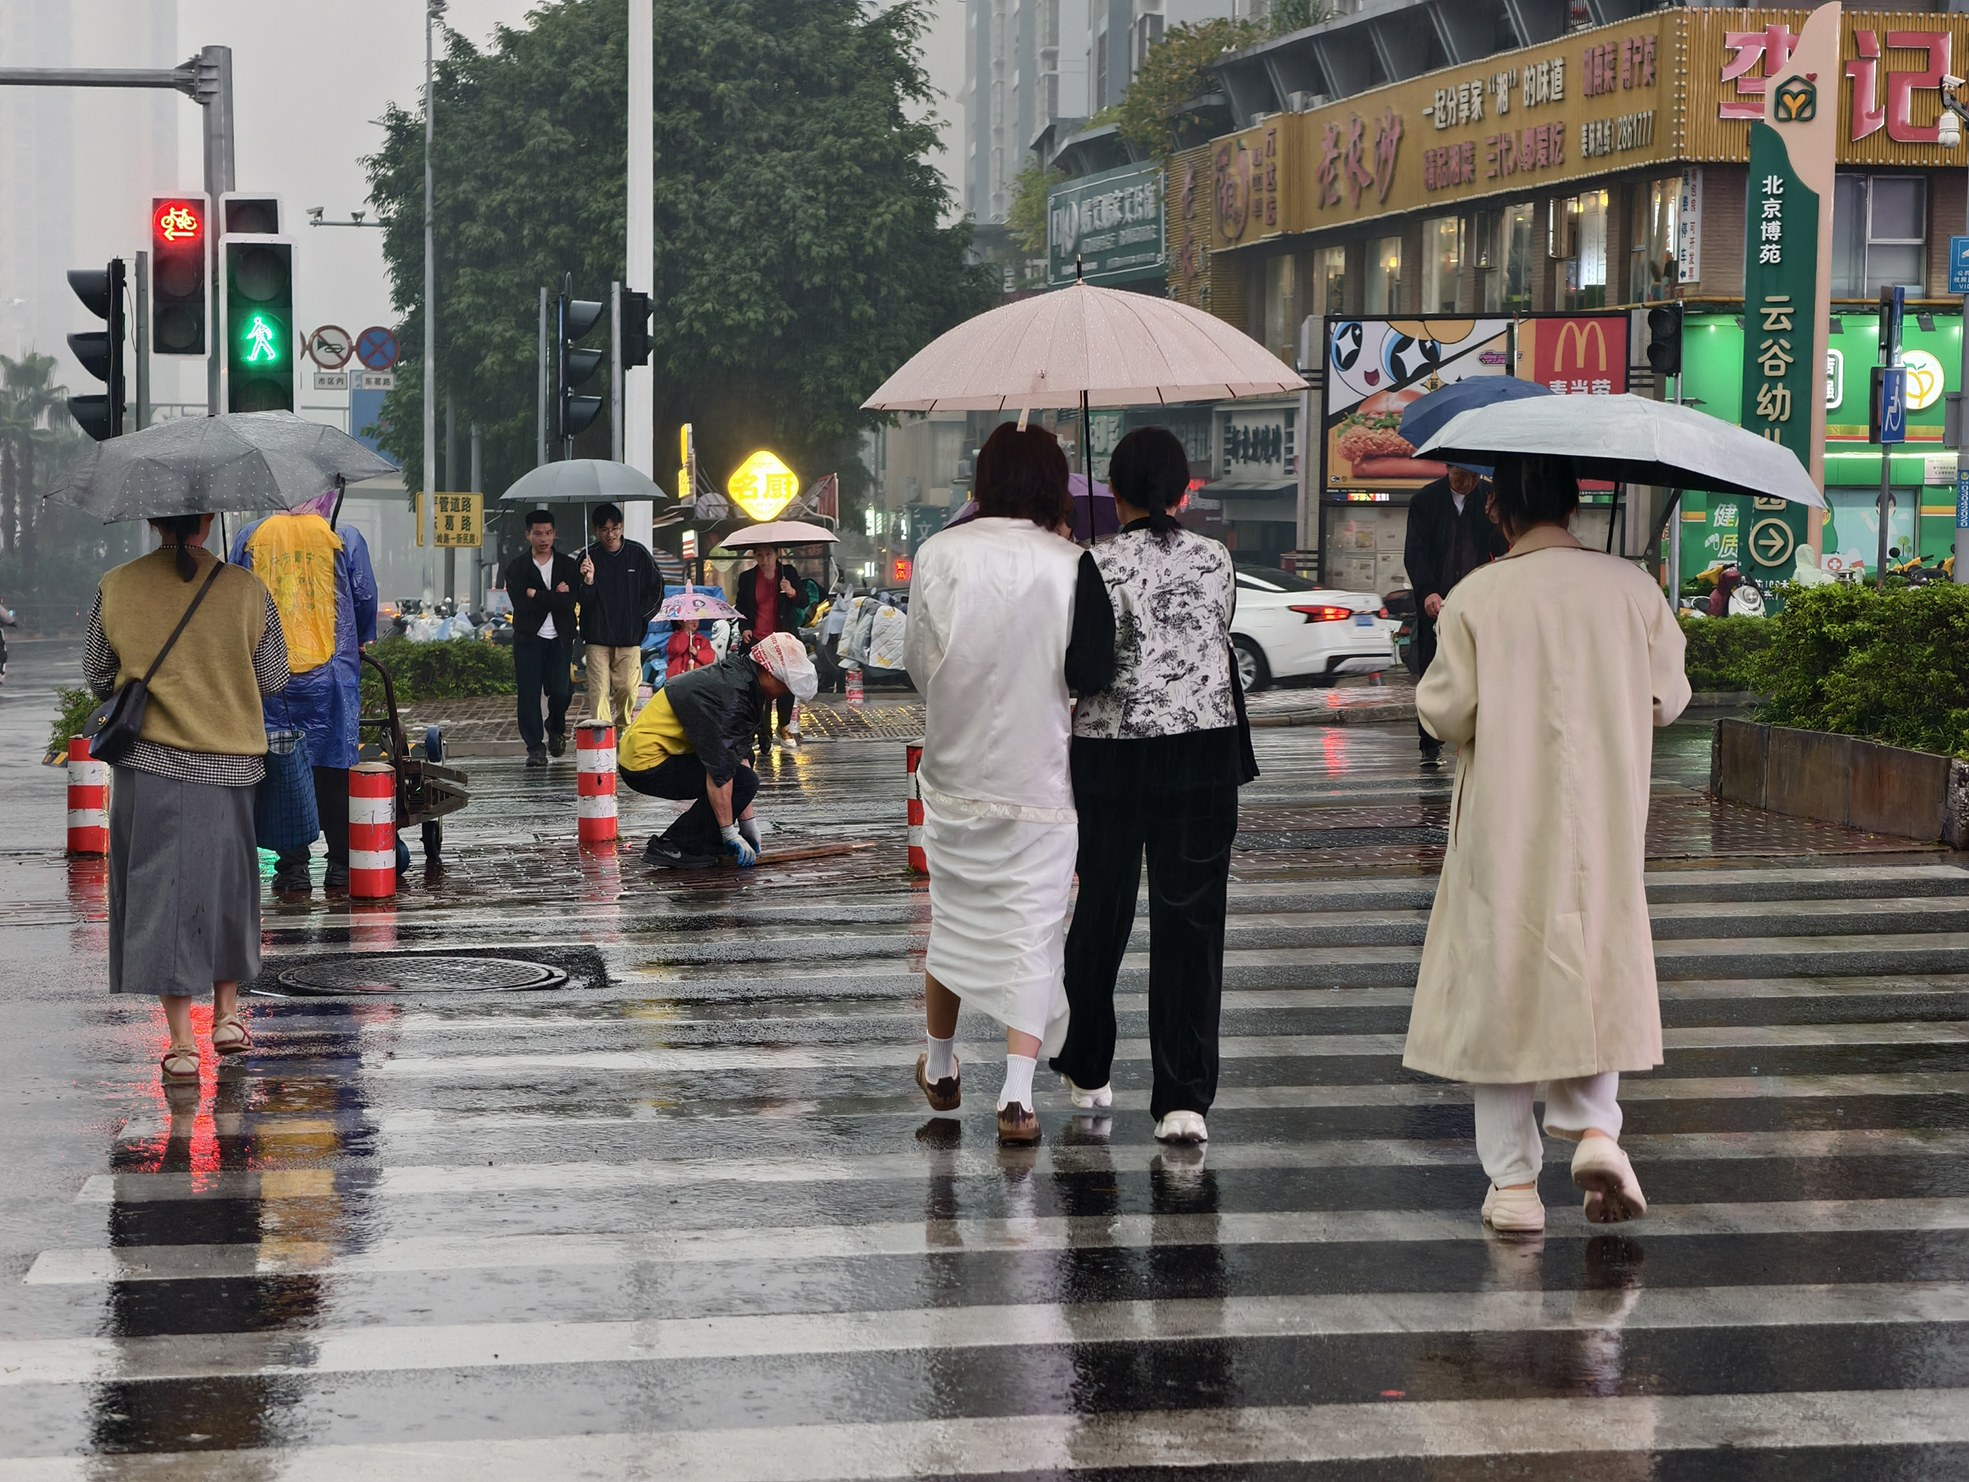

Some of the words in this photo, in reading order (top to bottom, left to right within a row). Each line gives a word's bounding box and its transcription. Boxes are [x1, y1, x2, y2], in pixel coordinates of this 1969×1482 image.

[1617, 110, 1654, 151] 2861777
[1759, 175, 1784, 264] 北京博苑
[732, 473, 794, 500] 名厨
[434, 496, 471, 512] 管道路
[434, 515, 471, 531] 葛路
